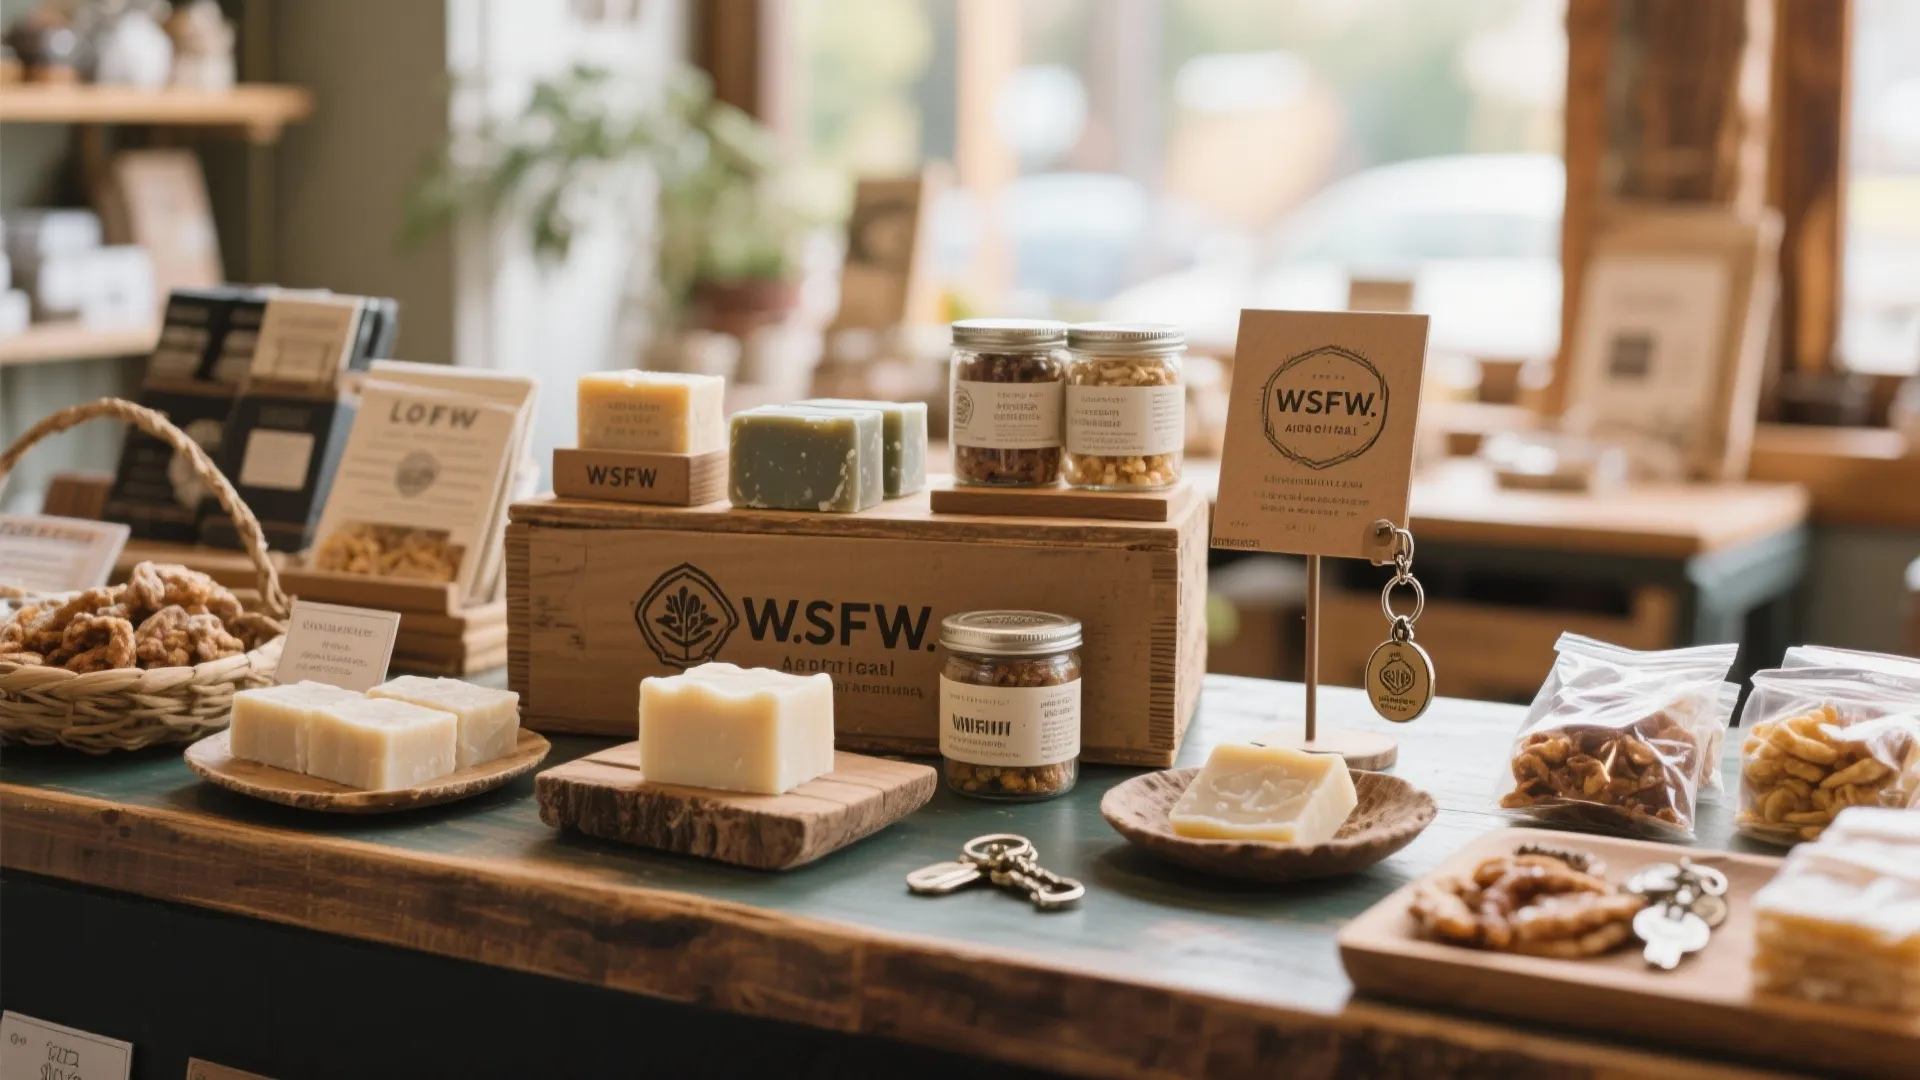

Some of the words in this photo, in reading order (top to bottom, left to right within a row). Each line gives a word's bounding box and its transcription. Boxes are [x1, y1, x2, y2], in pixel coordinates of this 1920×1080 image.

[389, 400, 480, 430] LOFW
[1276, 388, 1377, 418] WSFW.
[586, 464, 657, 489] WSFW
[743, 597, 936, 653] W.SFW.
